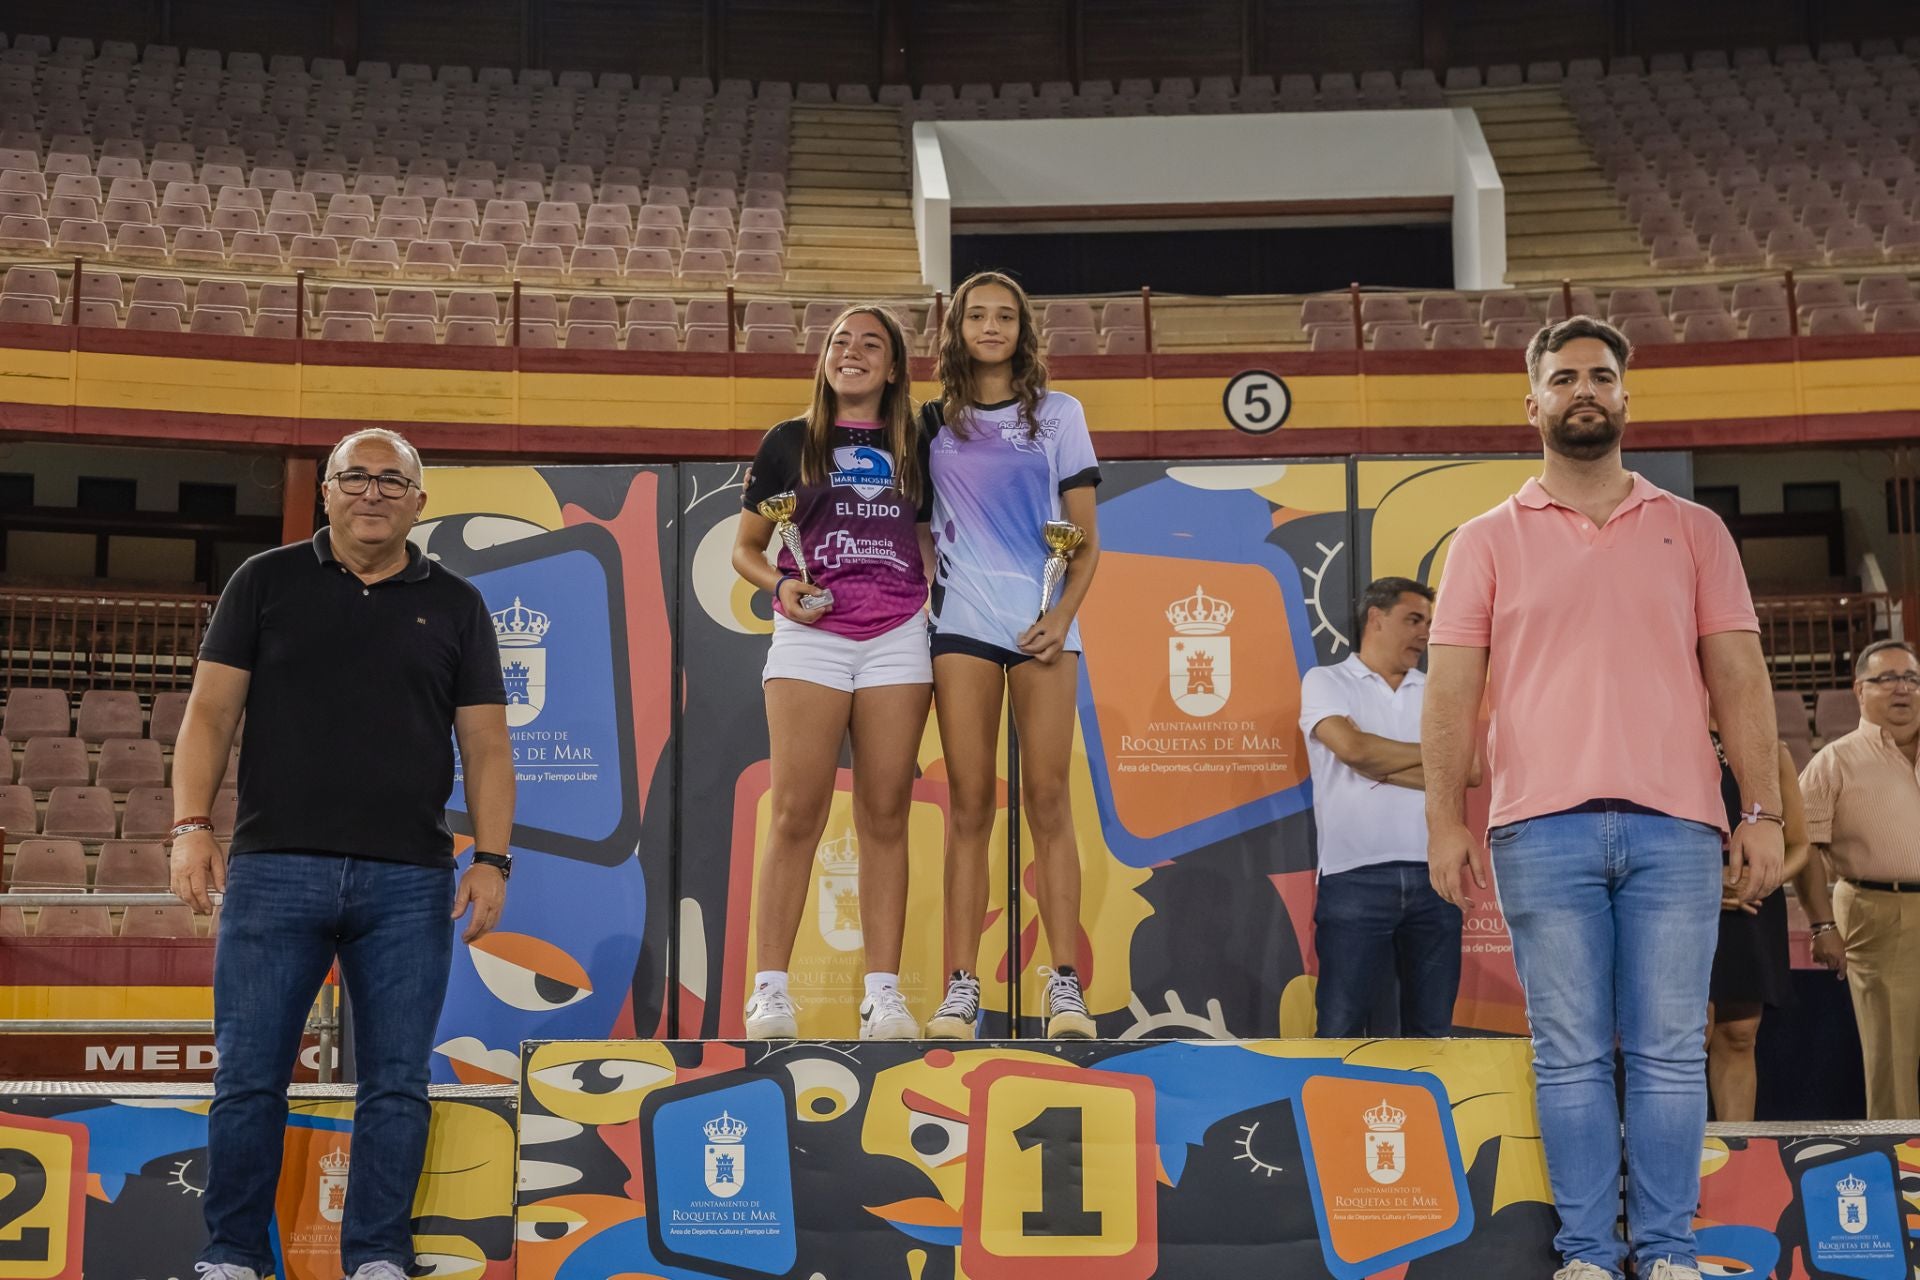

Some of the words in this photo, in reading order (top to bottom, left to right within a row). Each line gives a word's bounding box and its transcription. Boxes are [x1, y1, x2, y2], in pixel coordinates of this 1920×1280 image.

[1244, 383, 1271, 423] 5
[861, 477, 895, 485] NOSTRU
[835, 502, 853, 516] EL
[857, 503, 900, 519] EJIDO
[837, 530, 893, 548] Farmacia
[844, 538, 896, 557] Auditorio
[1148, 721, 1238, 732] AYUNTAMIENTO
[1241, 721, 1256, 731] DE
[554, 731, 568, 741] DE
[1121, 735, 1207, 753] ROQUETAS
[1214, 738, 1234, 750] DE
[1242, 735, 1282, 750] MAR
[527, 747, 547, 760] DE
[554, 744, 592, 760] MAR
[1118, 762, 1138, 772] Área
[1139, 763, 1149, 772] de
[1151, 763, 1192, 774] Deportes,
[1193, 762, 1224, 772] Cultura
[1225, 764, 1231, 773] y
[1232, 763, 1264, 773] Tiempo
[1266, 761, 1287, 771] Libre
[537, 774, 544, 783] y
[544, 772, 575, 782] Tiempo
[577, 772, 598, 781] Libre
[1472, 943, 1484, 953] de
[788, 972, 852, 986] OQUETAS
[1013, 1107, 1102, 1236] 1
[0, 1148, 50, 1261] 2
[690, 1200, 749, 1208] AYUNTAMIENTO
[1336, 1195, 1391, 1208] ROQUETAS
[1395, 1198, 1408, 1207] DE
[1412, 1196, 1438, 1206] MAR
[673, 1209, 728, 1223] ROQUETAS
[733, 1211, 746, 1221] DE
[750, 1209, 776, 1221] MAR
[744, 1228, 765, 1236] Tiempo
[1818, 1241, 1858, 1250] ROQUETAS
[1873, 1240, 1891, 1249] MAR
